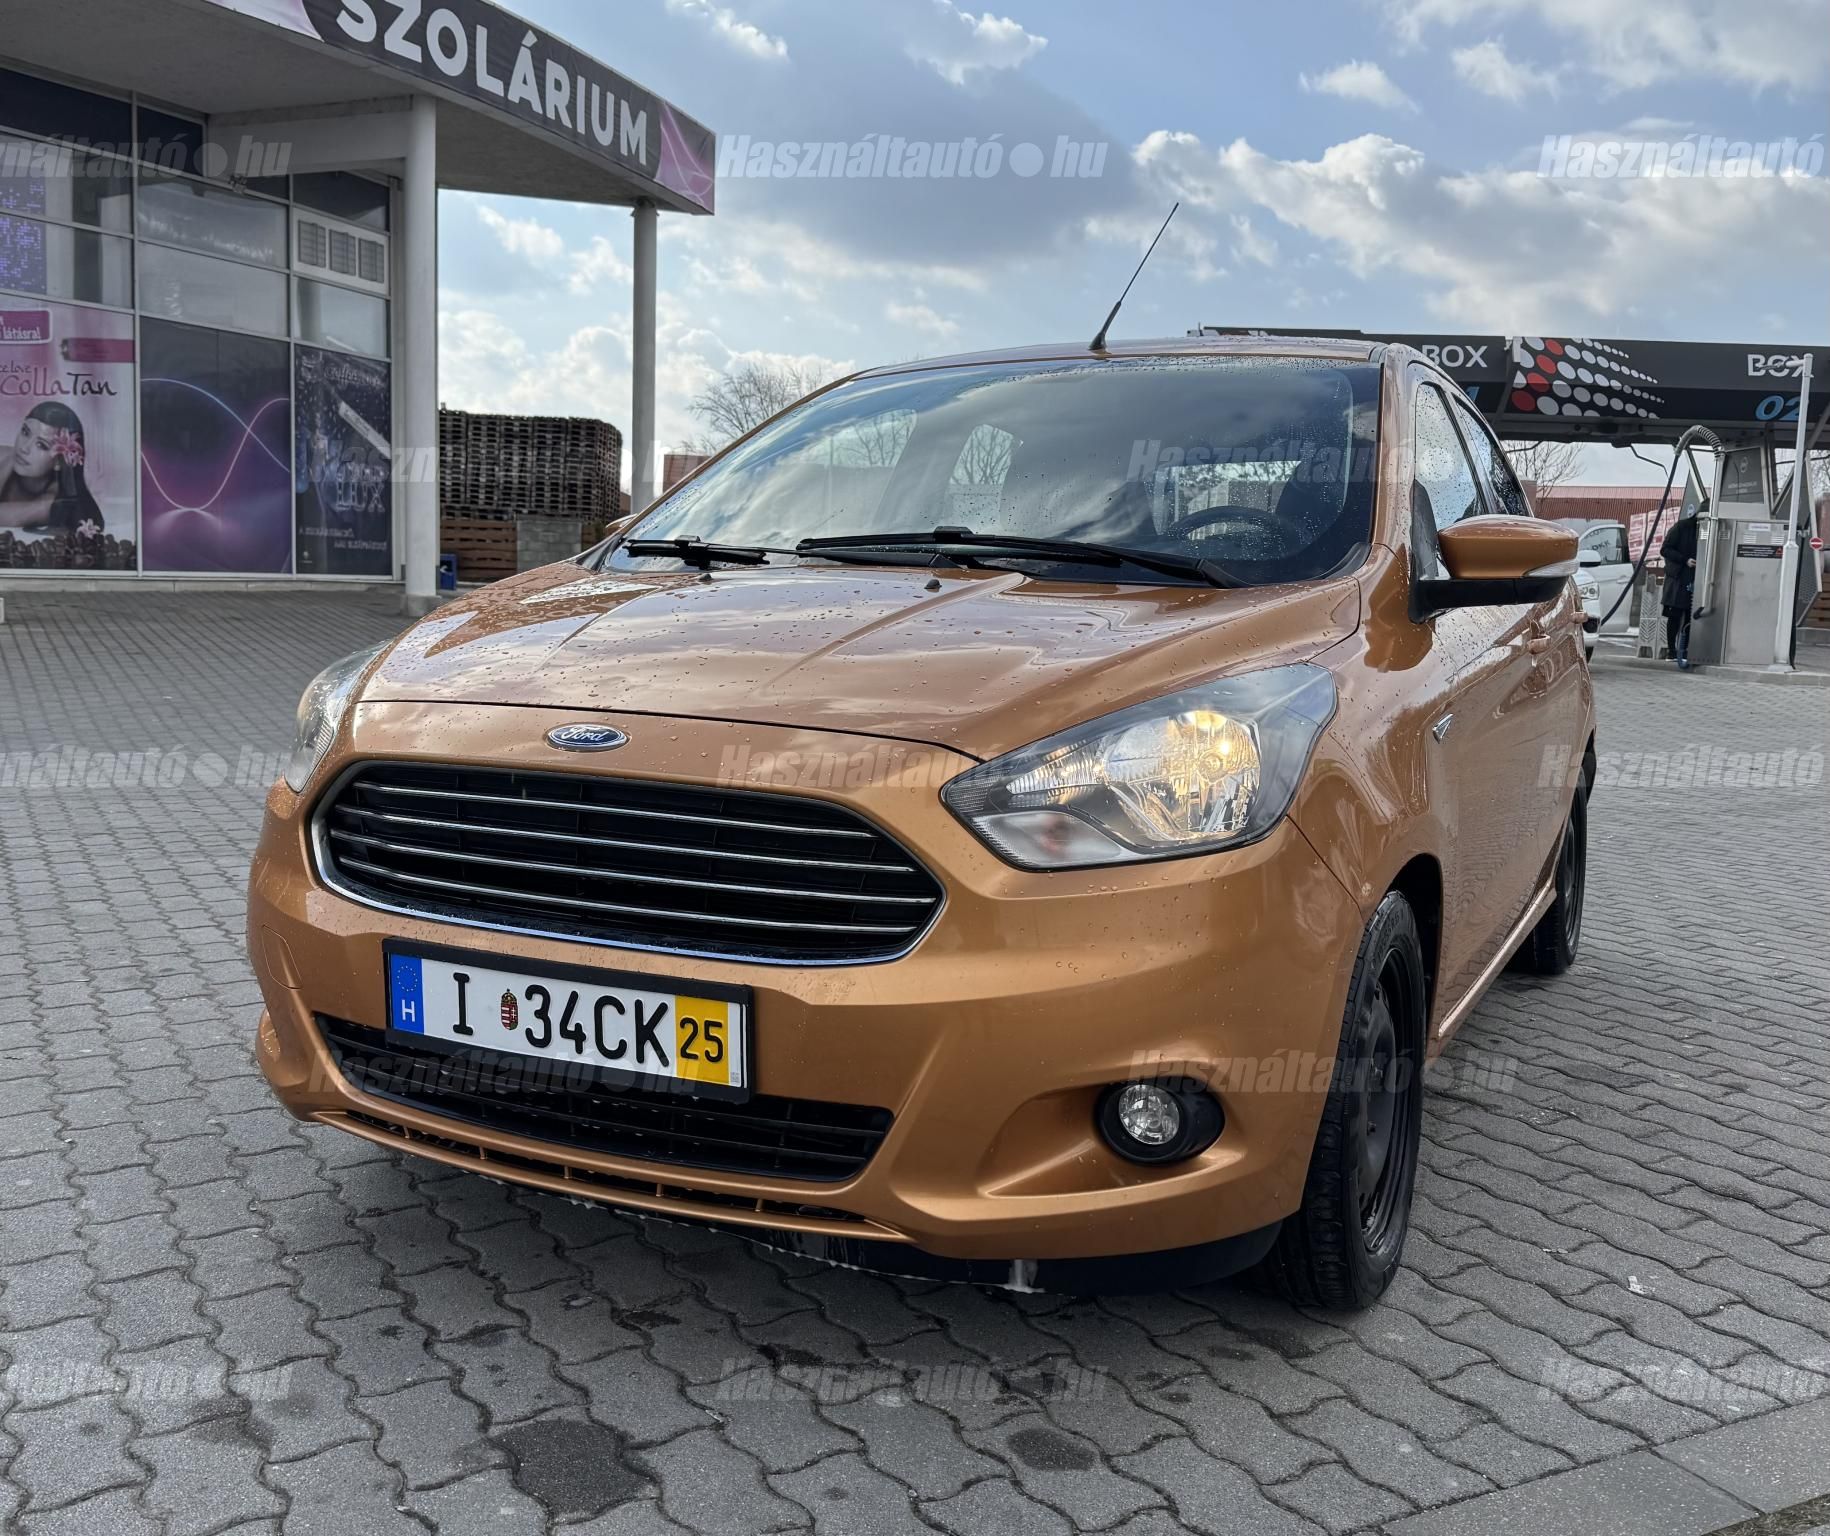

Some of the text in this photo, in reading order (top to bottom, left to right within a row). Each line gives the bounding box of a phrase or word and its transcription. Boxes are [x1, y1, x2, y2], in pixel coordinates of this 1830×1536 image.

[336, 0, 648, 166] SZOLÁRIUM
[1421, 344, 1488, 368] BOX
[1747, 353, 1815, 378] BOX
[561, 725, 610, 741] Ford
[402, 1000, 415, 1023] H
[679, 1017, 724, 1063] 25
